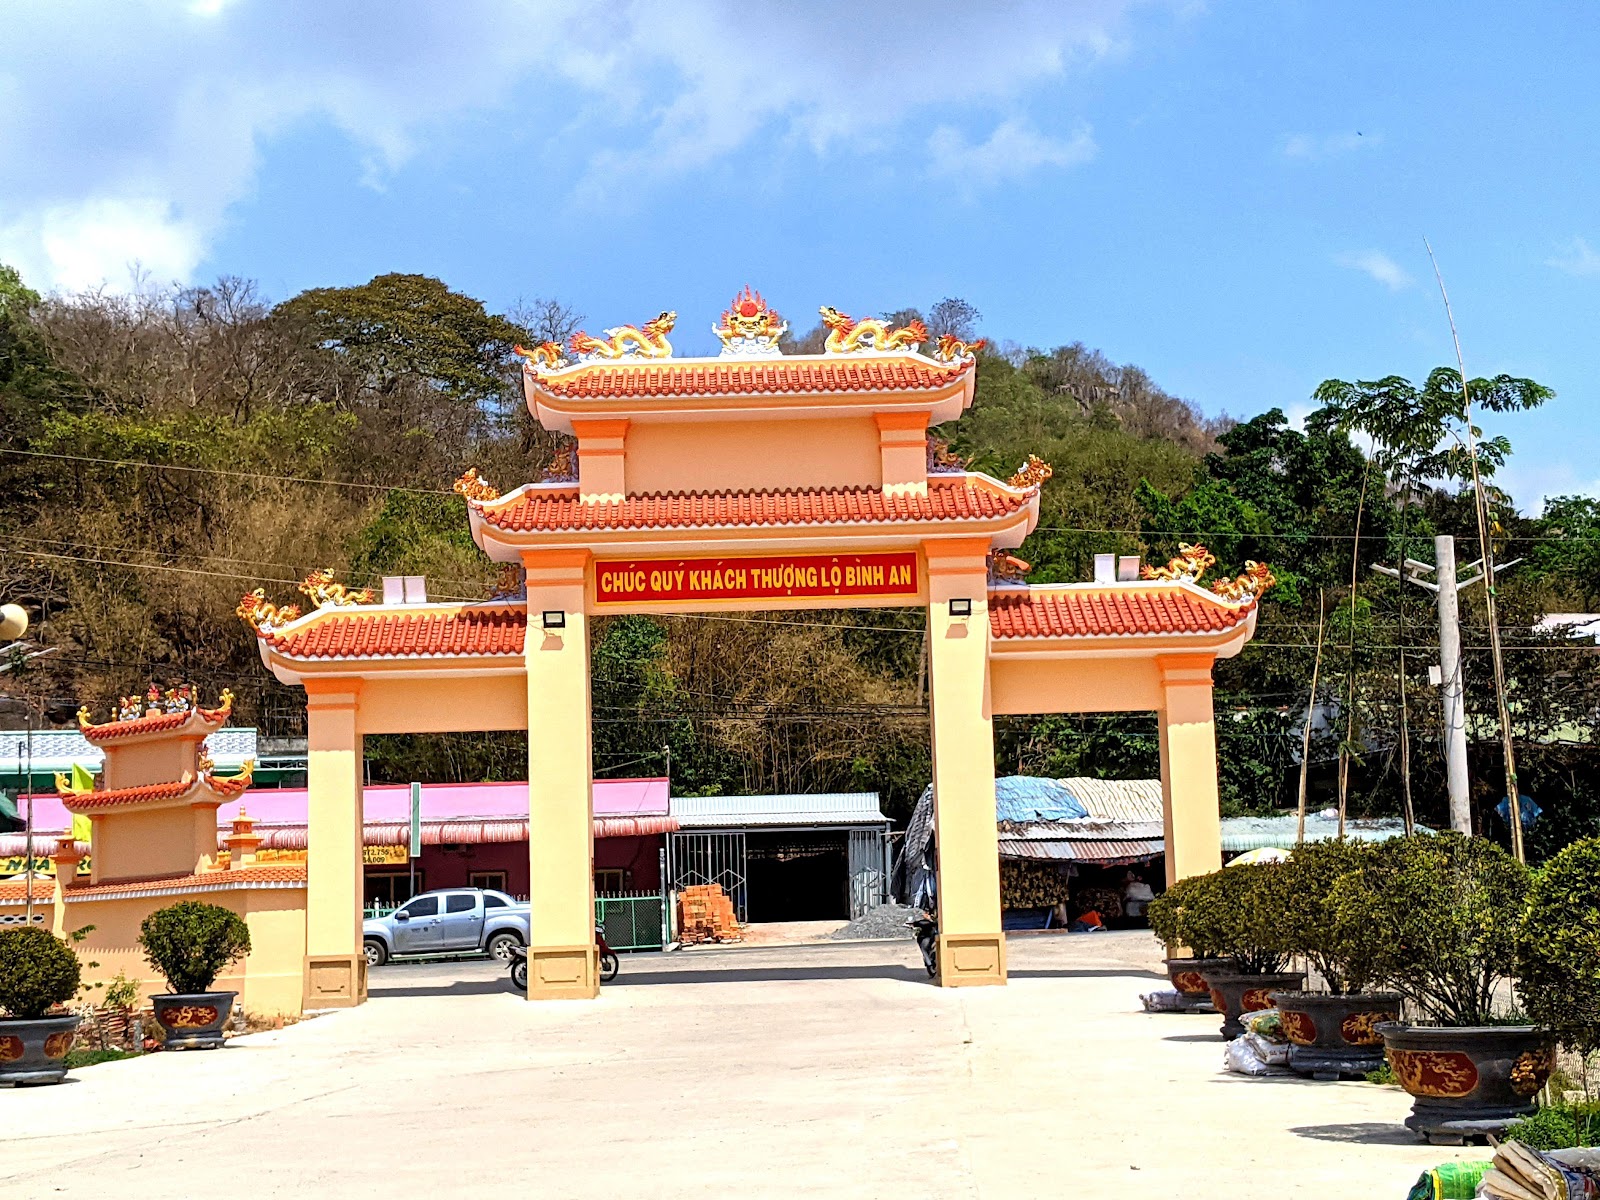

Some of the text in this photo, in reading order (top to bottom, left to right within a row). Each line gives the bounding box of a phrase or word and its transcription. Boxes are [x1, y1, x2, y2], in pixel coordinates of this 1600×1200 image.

[601, 558, 912, 595] CHÚC QUÝ KHÁCH THƯỢNG LỘ BÌNH AN
